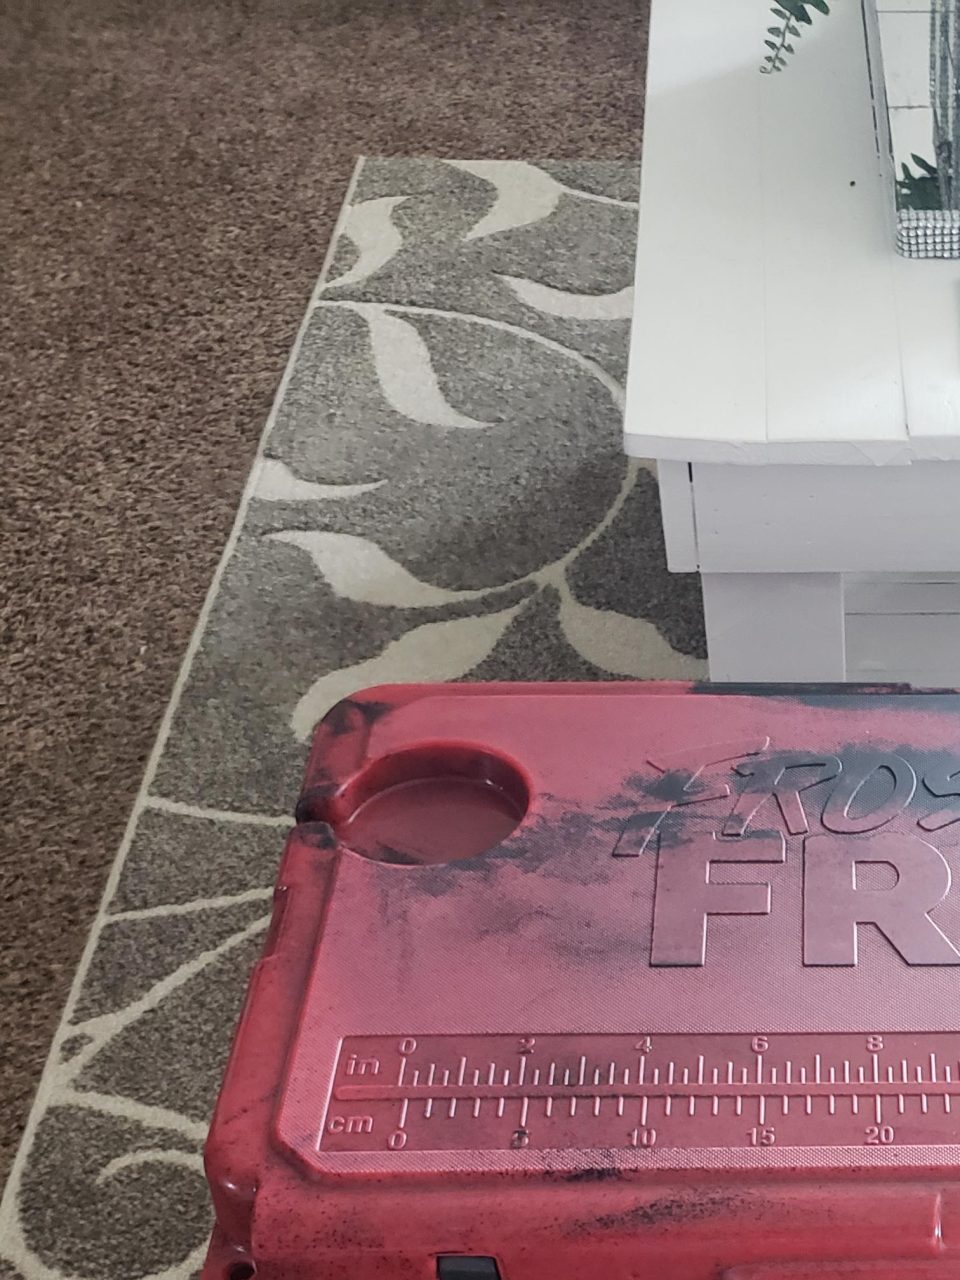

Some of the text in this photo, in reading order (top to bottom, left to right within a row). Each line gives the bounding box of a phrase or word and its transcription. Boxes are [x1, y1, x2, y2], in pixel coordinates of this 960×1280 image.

[346, 1054, 379, 1075] in
[400, 1037, 417, 1054] 0
[519, 1037, 536, 1054] 2
[635, 1036, 653, 1053] 4
[751, 1036, 769, 1053] 6
[867, 1035, 884, 1051] 8
[328, 1115, 373, 1133] cm
[388, 1132, 407, 1150] 0
[511, 1130, 530, 1148] 5
[627, 1129, 656, 1147] 10
[747, 1128, 776, 1146] 15
[865, 1126, 894, 1144] 20
